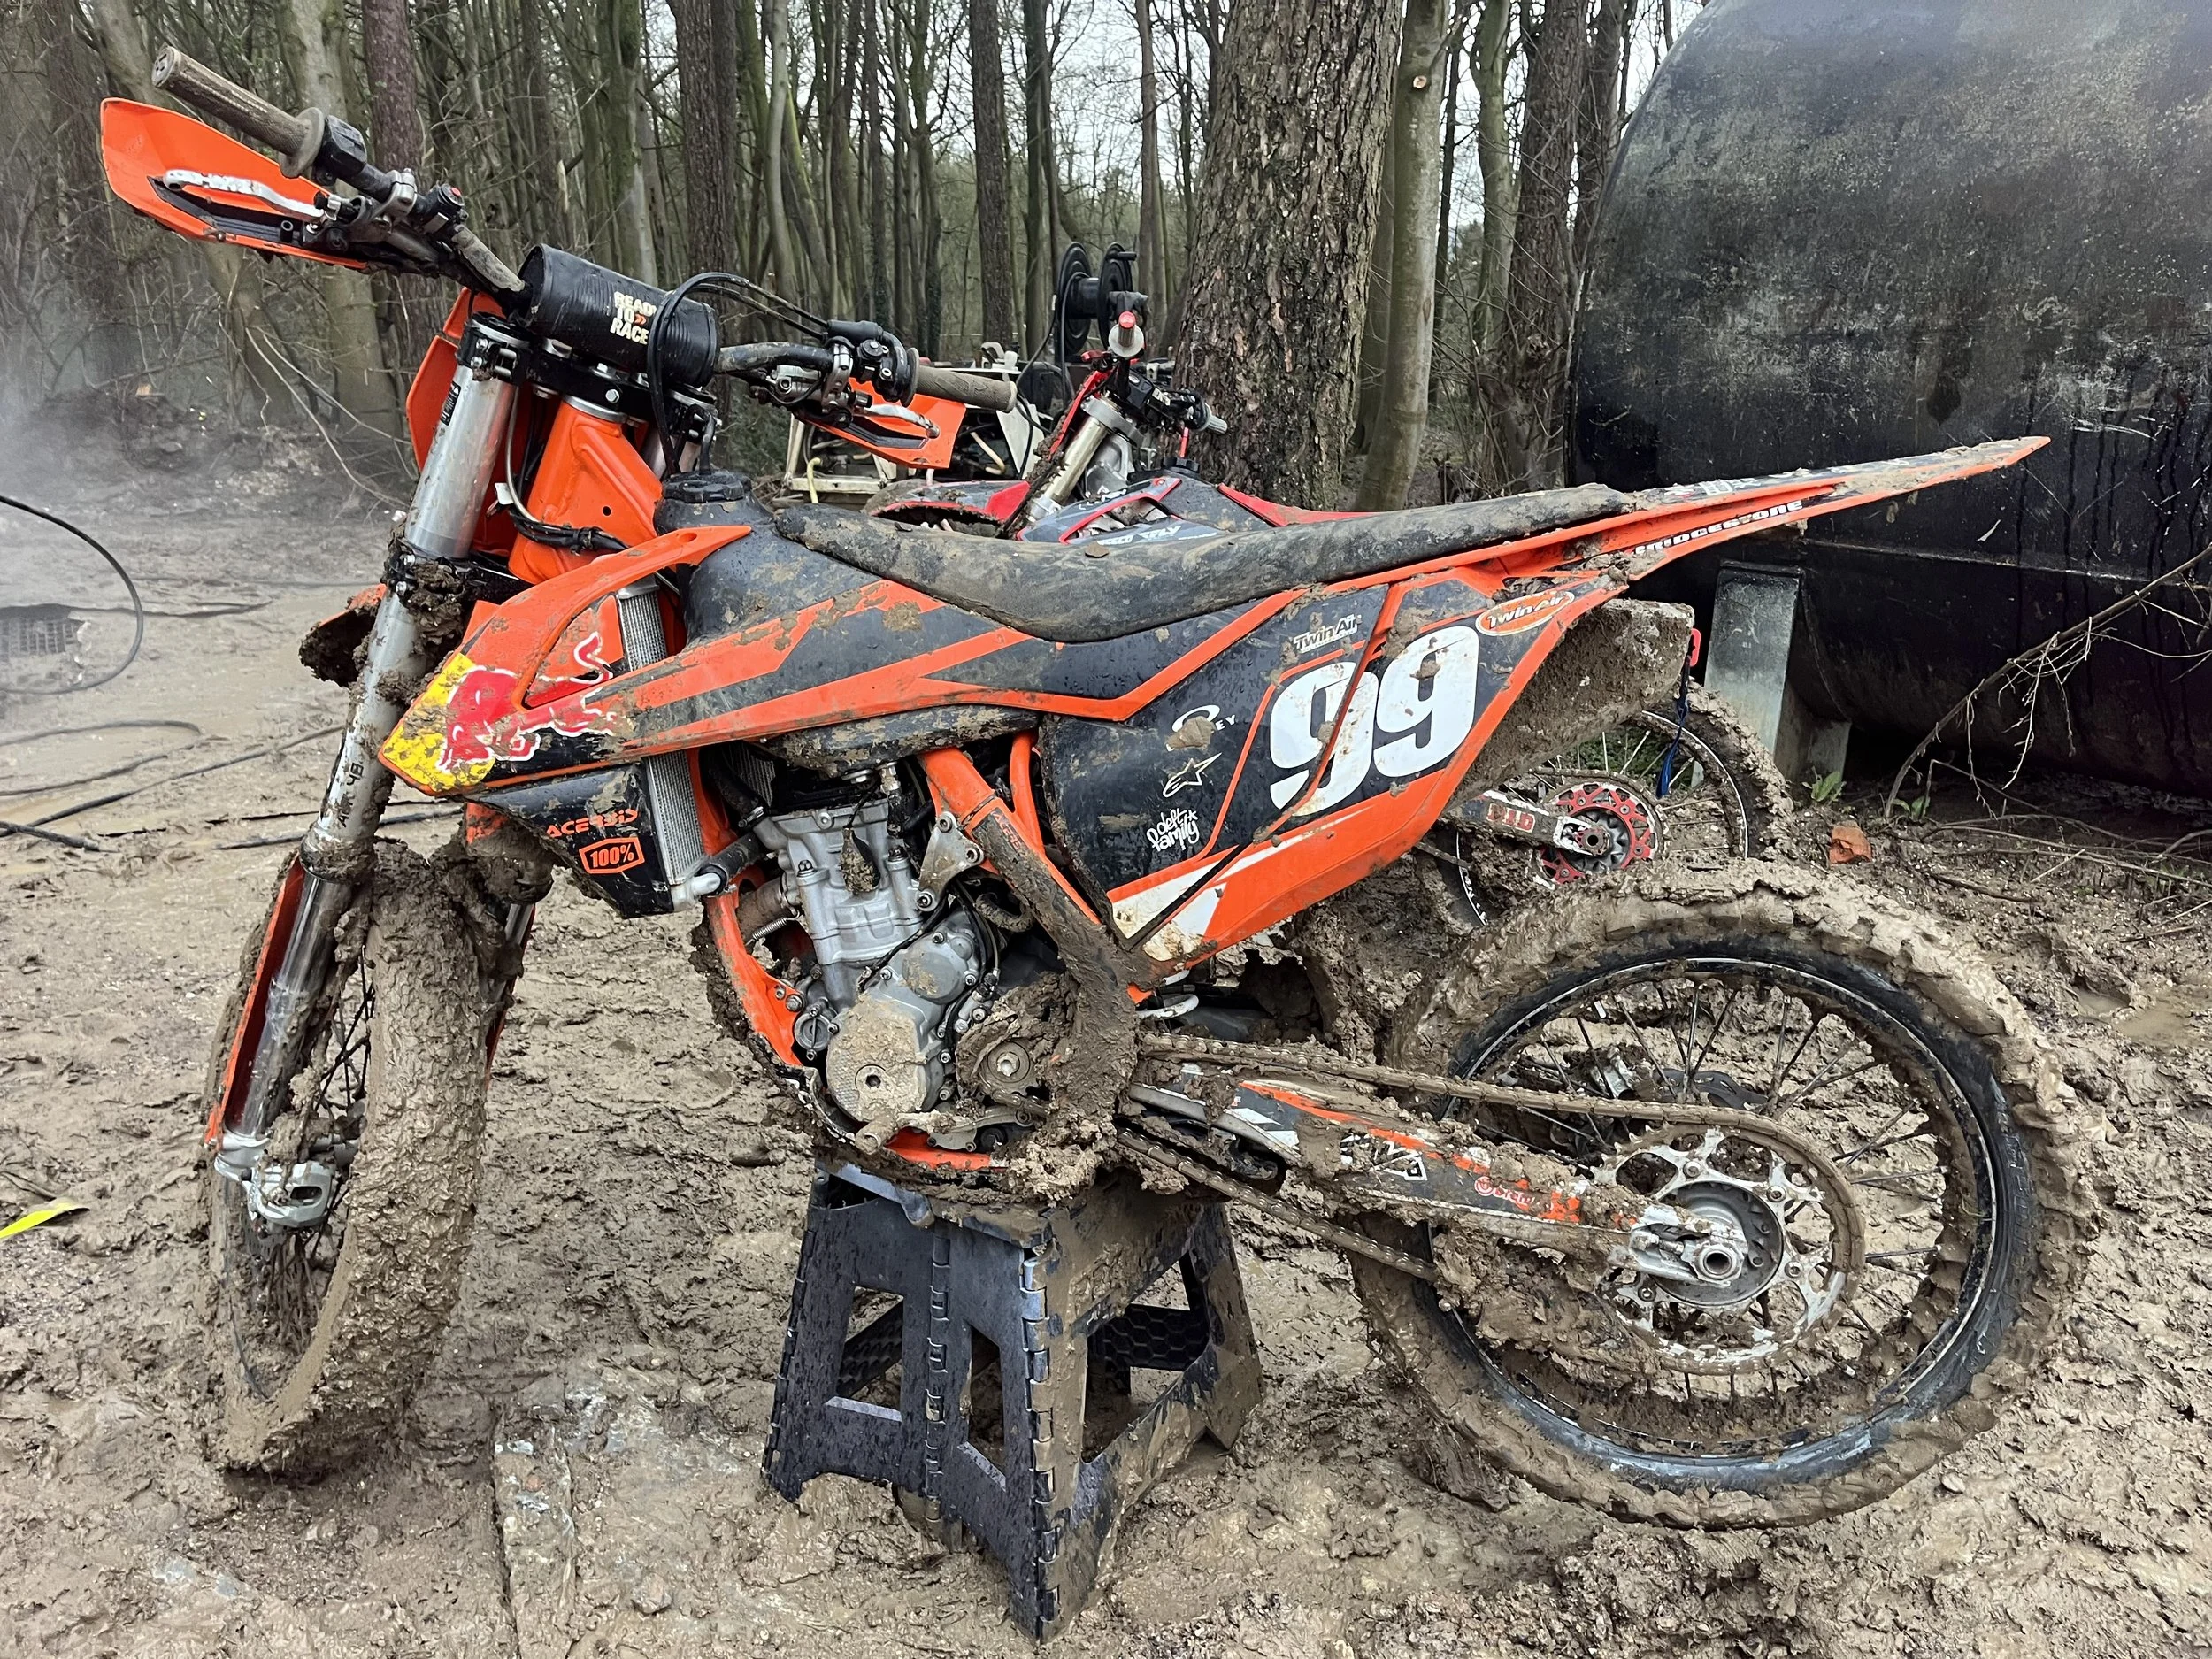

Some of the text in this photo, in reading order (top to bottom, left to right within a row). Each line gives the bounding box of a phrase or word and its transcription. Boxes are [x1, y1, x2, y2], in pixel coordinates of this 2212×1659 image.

[617, 306, 635, 324] TO
[610, 317, 649, 345] RACE
[1487, 603, 1533, 628] Twin
[1294, 626, 1334, 651] Twin
[1270, 626, 1479, 817] 99
[1146, 811, 1200, 852] family
[1156, 808, 1188, 834] deft
[589, 843, 635, 868] 100%
